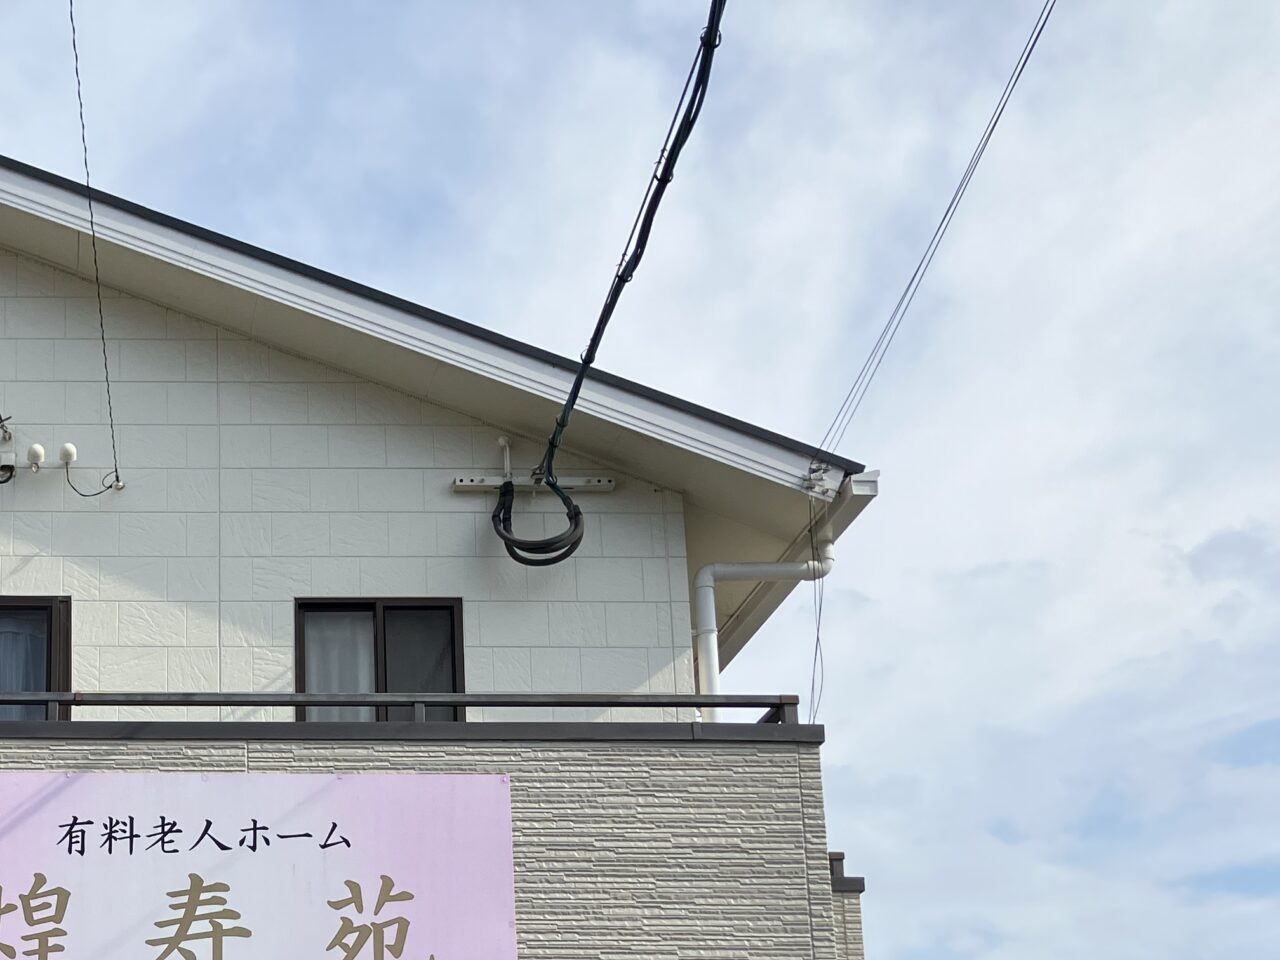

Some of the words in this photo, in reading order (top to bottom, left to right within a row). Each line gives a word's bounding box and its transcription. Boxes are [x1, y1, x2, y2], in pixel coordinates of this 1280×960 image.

[56, 815, 352, 857] 有料老人ホーム
